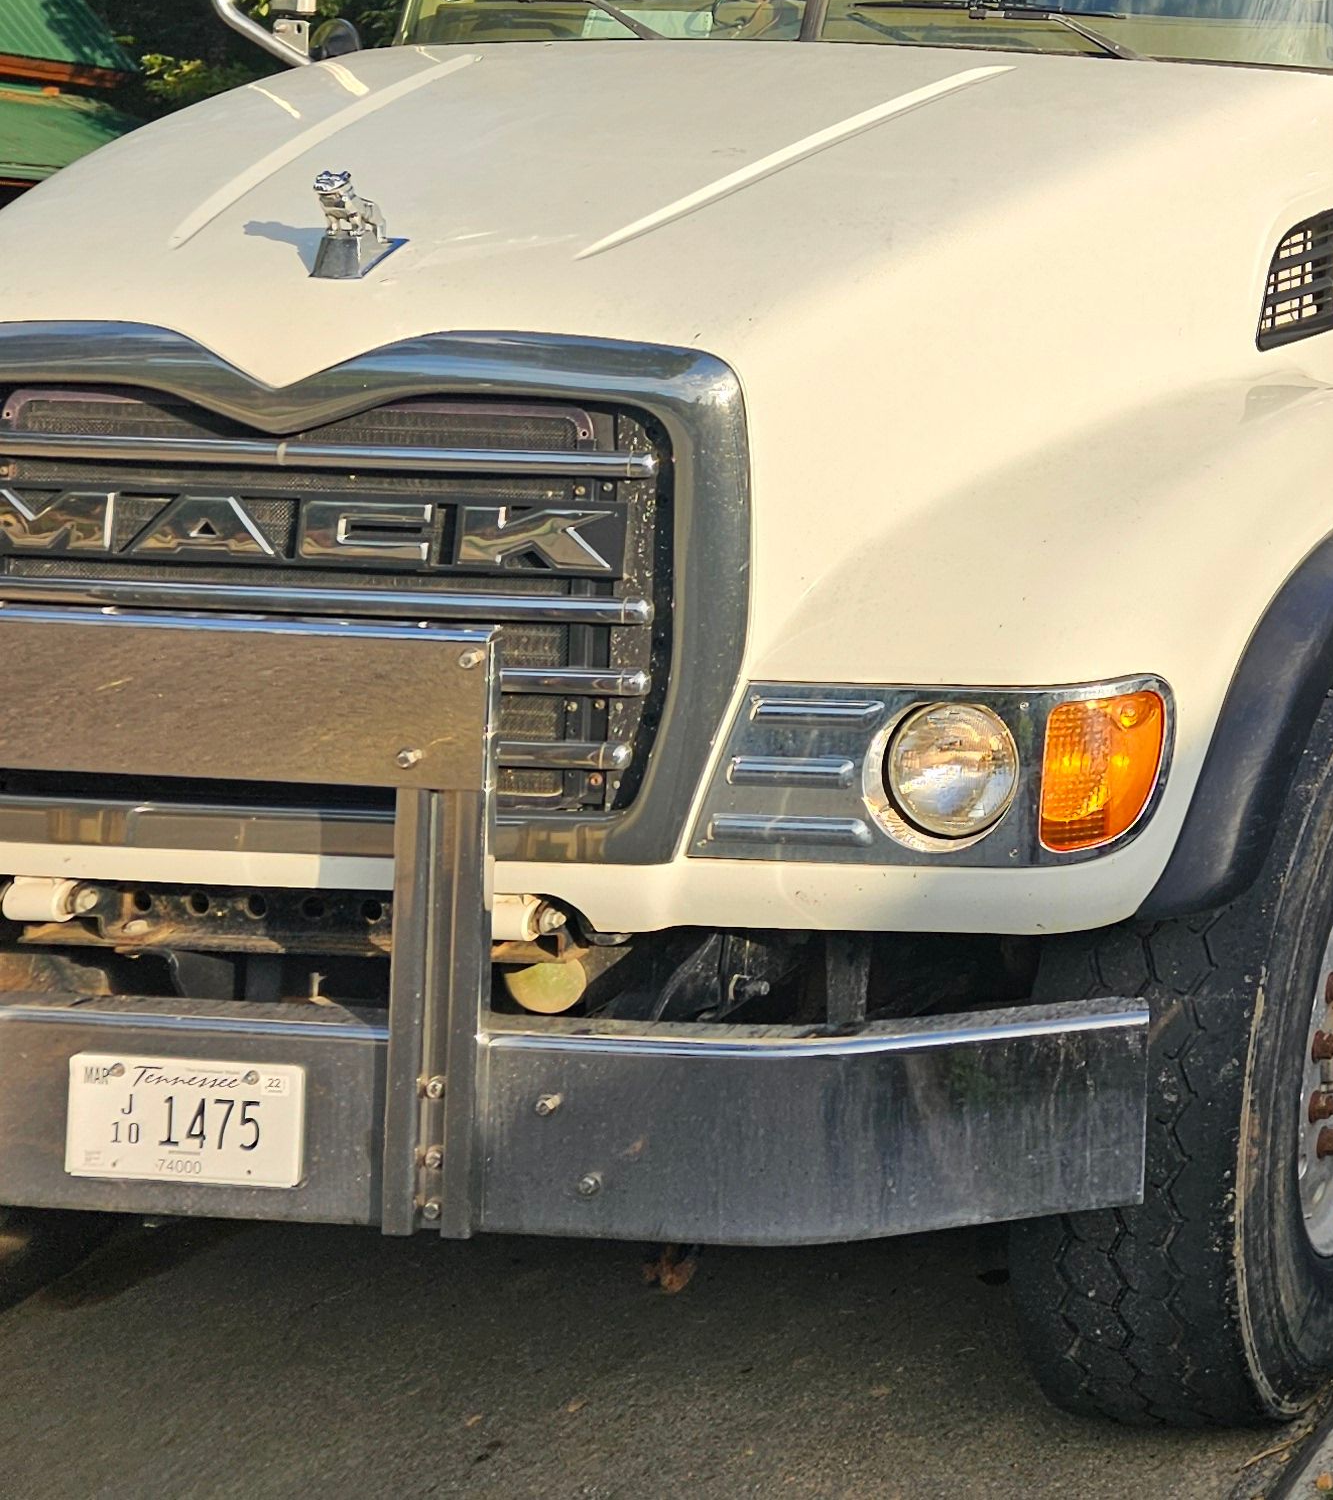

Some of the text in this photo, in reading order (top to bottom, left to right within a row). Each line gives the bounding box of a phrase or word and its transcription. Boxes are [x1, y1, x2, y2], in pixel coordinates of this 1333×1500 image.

[84, 1066, 109, 1085] MAR
[132, 1065, 241, 1089] Tennessee
[265, 1077, 282, 1089] 22
[110, 1120, 141, 1145] 10
[120, 1093, 261, 1151] J 1475
[156, 1158, 202, 1175] 74000
